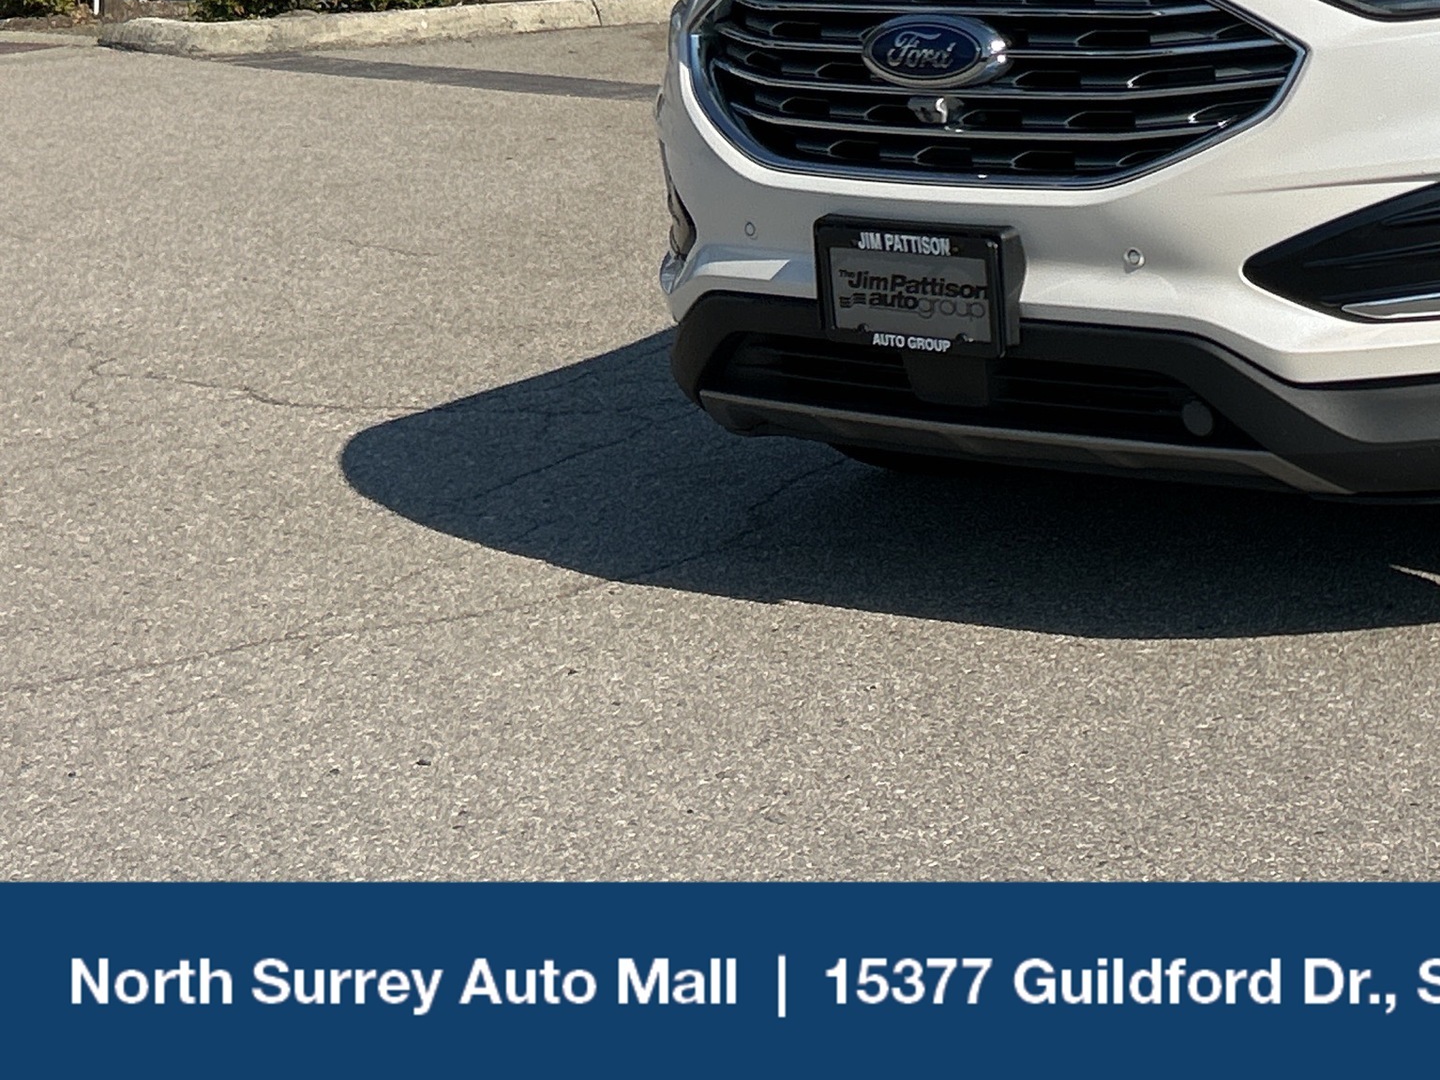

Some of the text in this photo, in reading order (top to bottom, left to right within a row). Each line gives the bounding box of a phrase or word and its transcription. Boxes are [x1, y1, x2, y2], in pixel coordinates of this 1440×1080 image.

[887, 30, 957, 69] Ford
[857, 231, 951, 257] JIM PATTISON
[872, 332, 951, 353] AUTO GROUP
